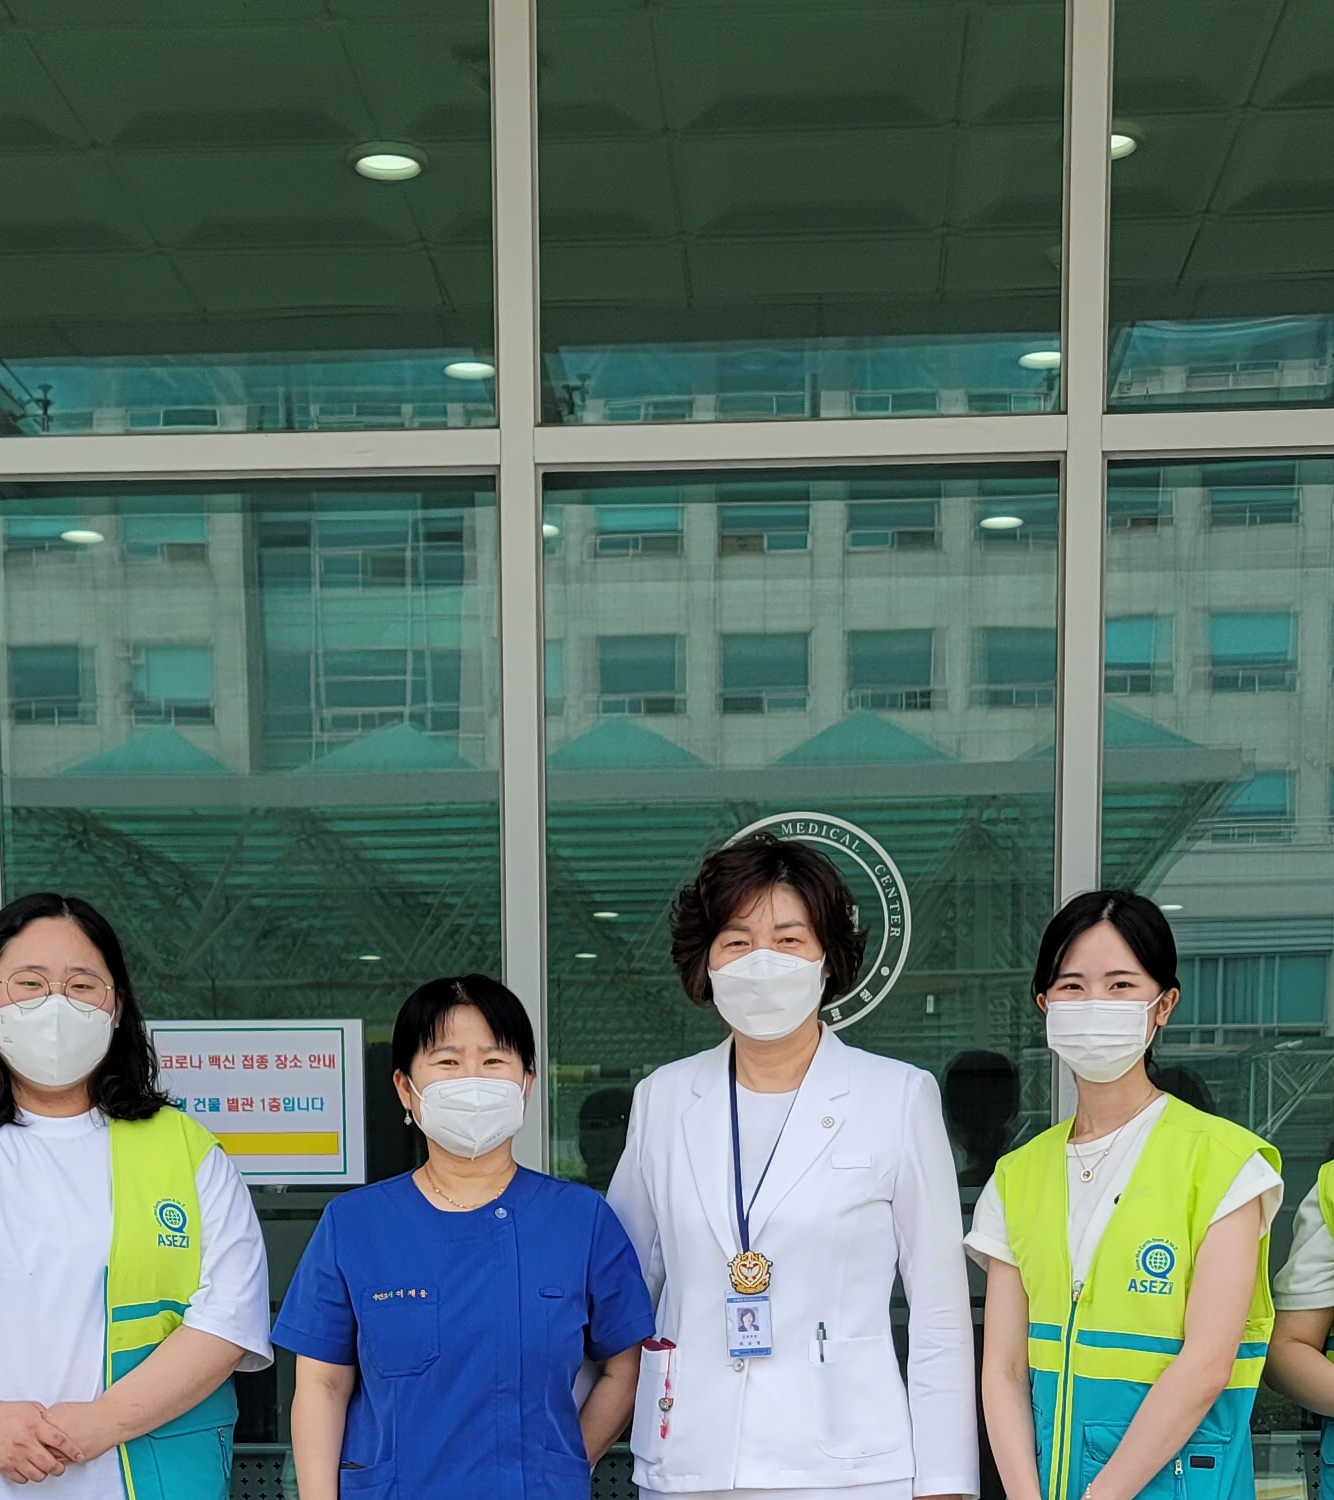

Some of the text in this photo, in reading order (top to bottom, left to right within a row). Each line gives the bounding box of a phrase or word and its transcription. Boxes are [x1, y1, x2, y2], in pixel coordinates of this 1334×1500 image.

[781, 822, 901, 938] MEDICAL CENTER
[161, 1054, 336, 1070] 코로나 백신 접종 장소 안내
[193, 1097, 221, 1112] 건물
[227, 1097, 254, 1112] 별관
[260, 1096, 325, 1112] 1층입니다
